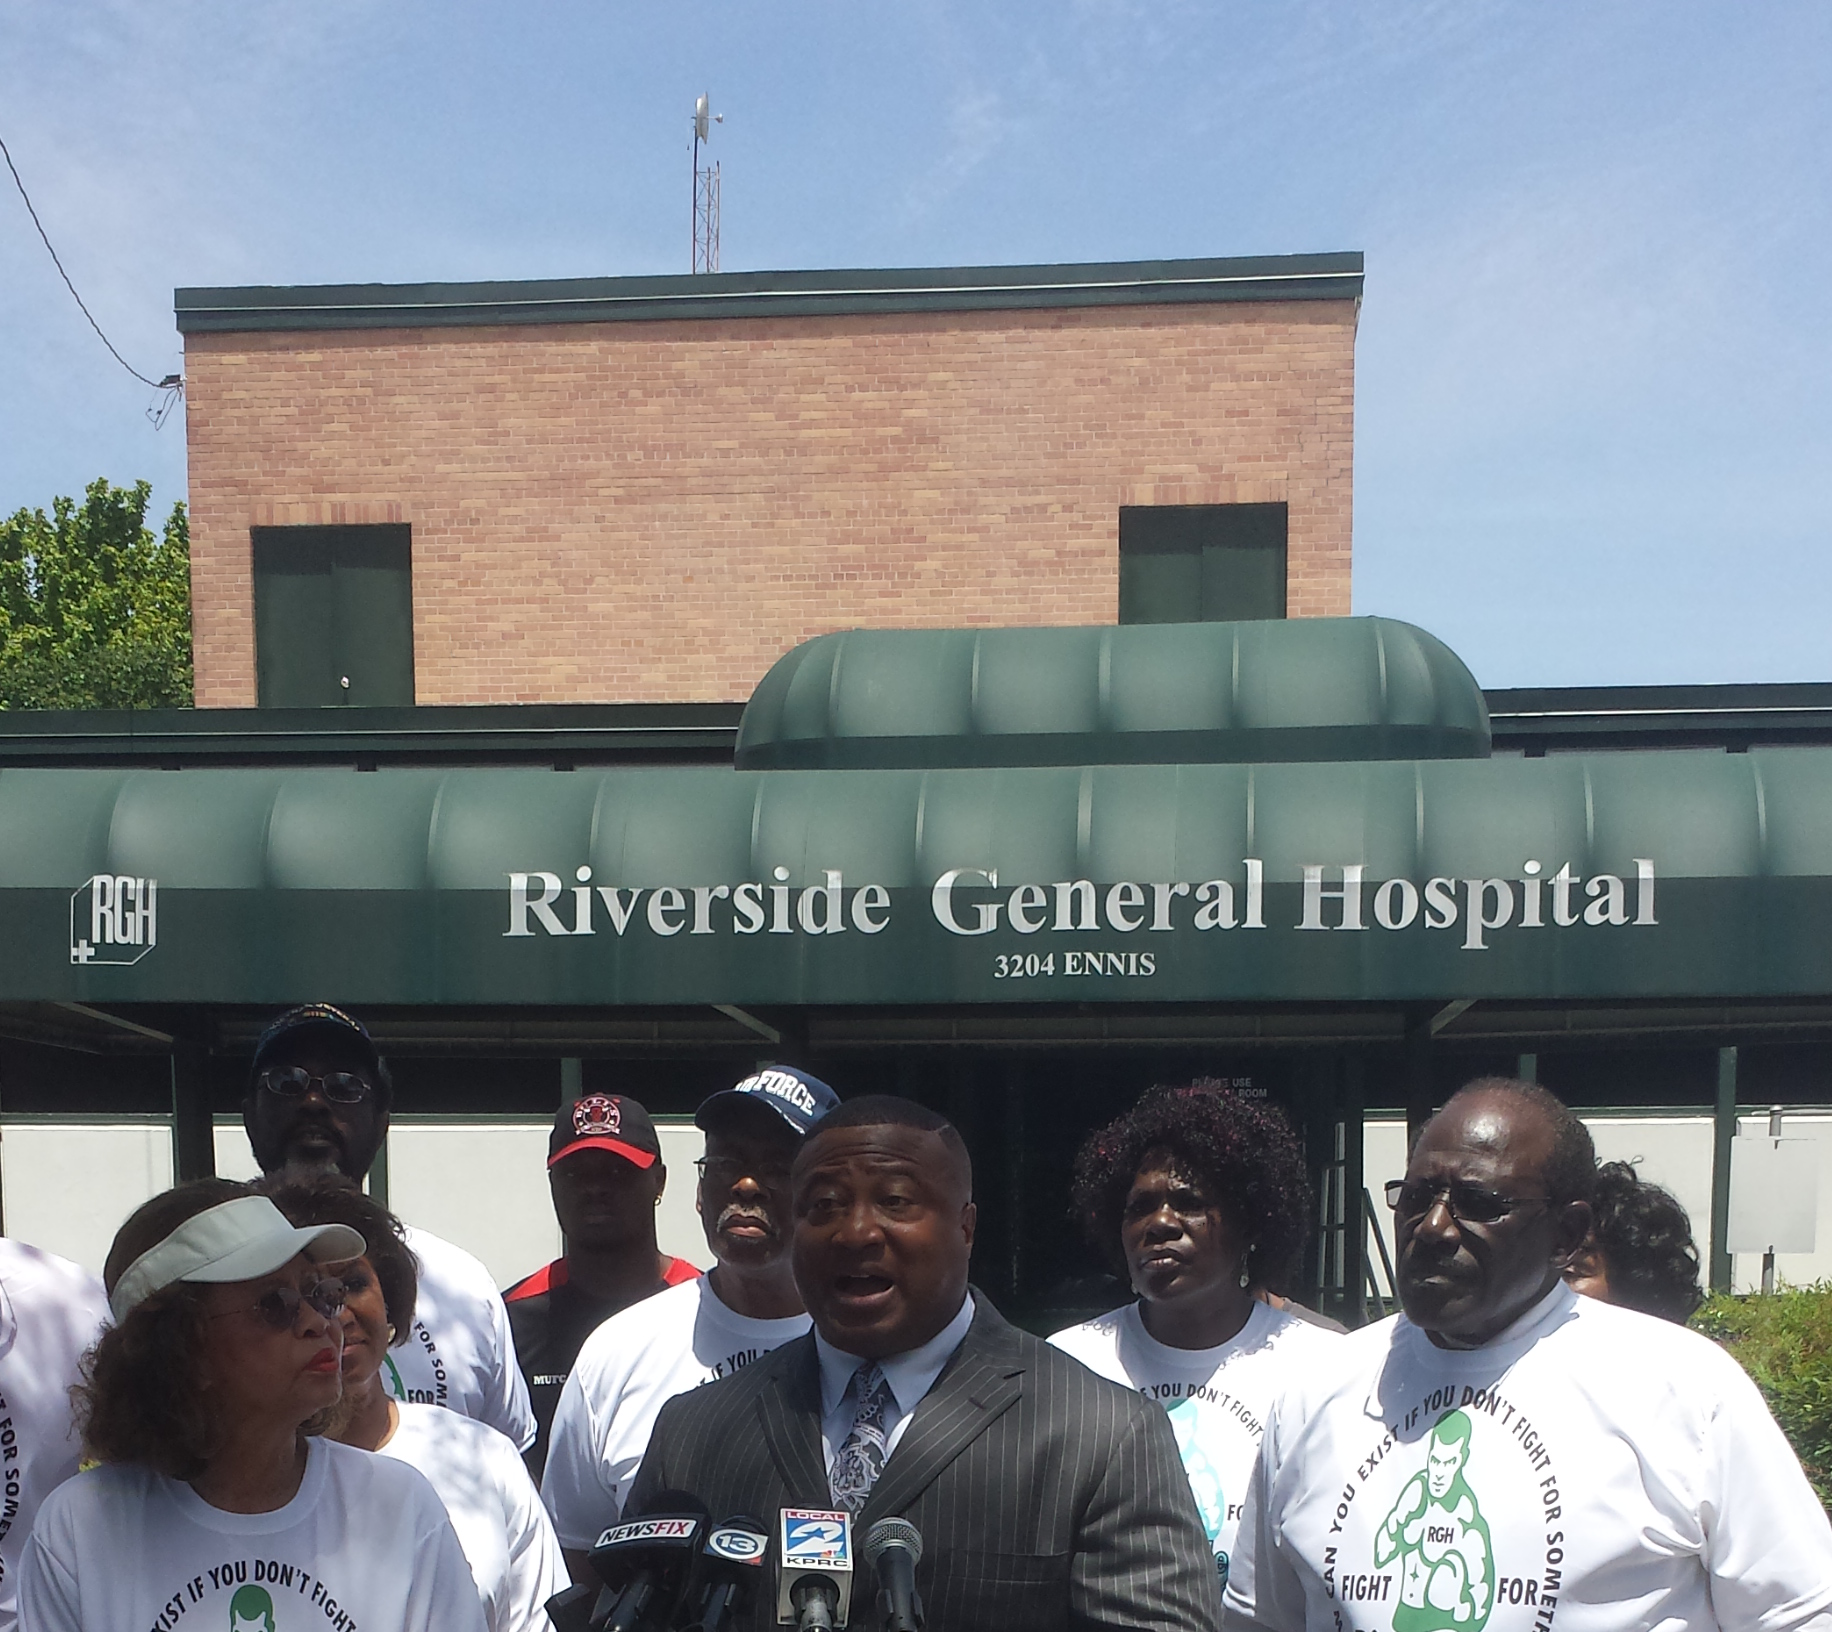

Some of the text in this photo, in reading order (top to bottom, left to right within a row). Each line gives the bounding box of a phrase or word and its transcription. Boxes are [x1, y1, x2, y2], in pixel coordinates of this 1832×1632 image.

[92, 874, 158, 946] RGH
[503, 858, 1660, 951] Riverside General Hospital
[994, 951, 1157, 978] 3204 ENNIS
[754, 1070, 817, 1117] FORCE
[1232, 1077, 1251, 1088] USE
[1238, 1088, 1268, 1098] ROOM
[414, 1322, 436, 1354] FOR
[1150, 1383, 1182, 1399] YOU
[1187, 1383, 1231, 1408] DON'T
[1229, 1400, 1264, 1437] FIGHT
[1423, 1385, 1455, 1416] YOU
[1460, 1385, 1516, 1427] DON'T
[1404, 1408, 1419, 1433] IF
[1357, 1424, 1400, 1483] EXIST
[1512, 1416, 1552, 1474] FIGHT
[787, 1511, 845, 1521] LOCAL
[1328, 1483, 1355, 1534] YOU
[1539, 1474, 1562, 1525] FOR
[601, 1521, 690, 1542] NEWSFIX
[718, 1534, 756, 1554] 13
[785, 1520, 845, 1555] 2
[1426, 1525, 1454, 1545] RGH
[786, 1556, 849, 1568] KPRC
[1324, 1546, 1339, 1599] CAN
[188, 1579, 205, 1604] IF
[208, 1560, 248, 1591] YOU
[254, 1559, 311, 1595] DON'T
[1341, 1574, 1539, 1607] FIGHT FOR
